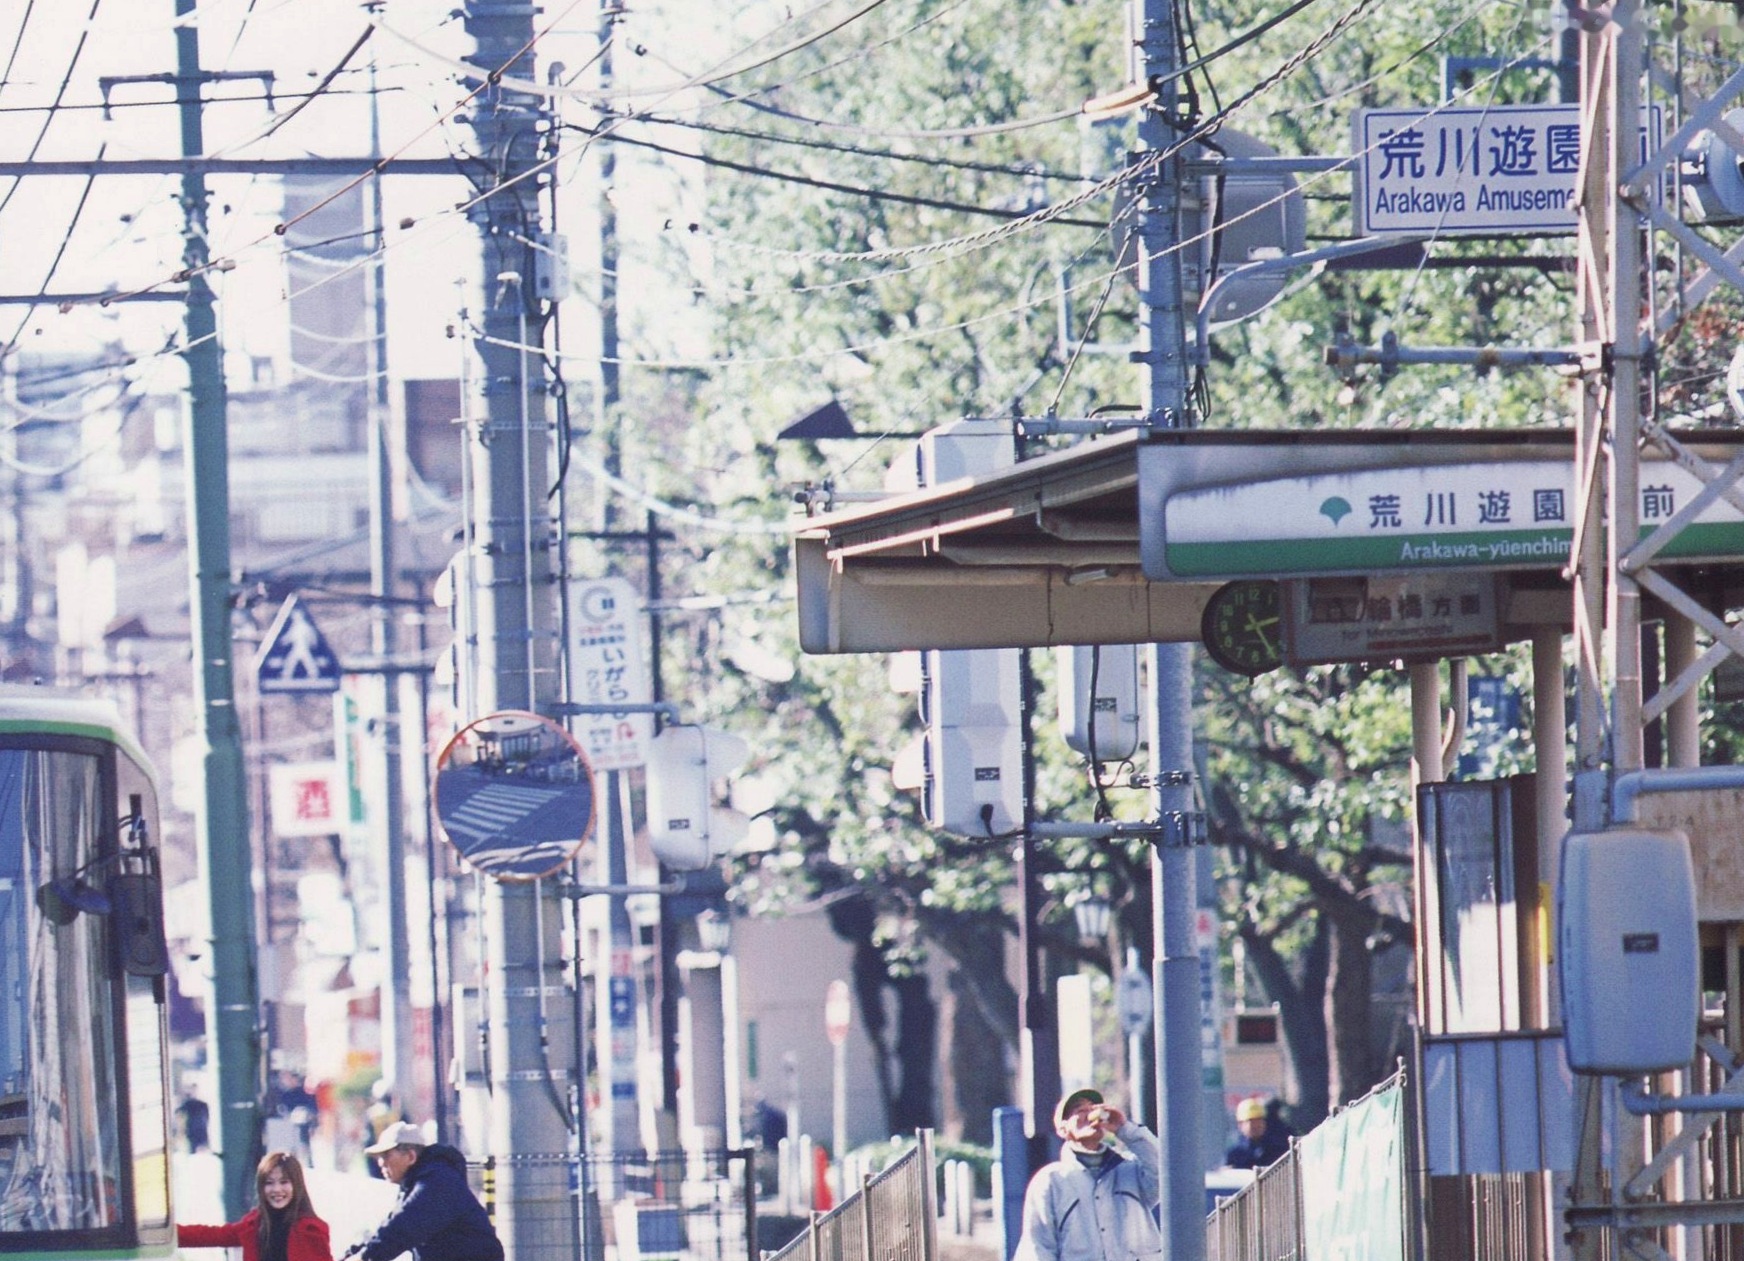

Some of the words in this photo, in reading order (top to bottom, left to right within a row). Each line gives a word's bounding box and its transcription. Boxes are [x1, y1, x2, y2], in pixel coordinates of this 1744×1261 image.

[1378, 125, 1648, 180] 荒川遊園
[1375, 186, 1465, 214] Arakawa
[1368, 484, 1675, 529] 荒川遊園前
[603, 648, 629, 720] いがら
